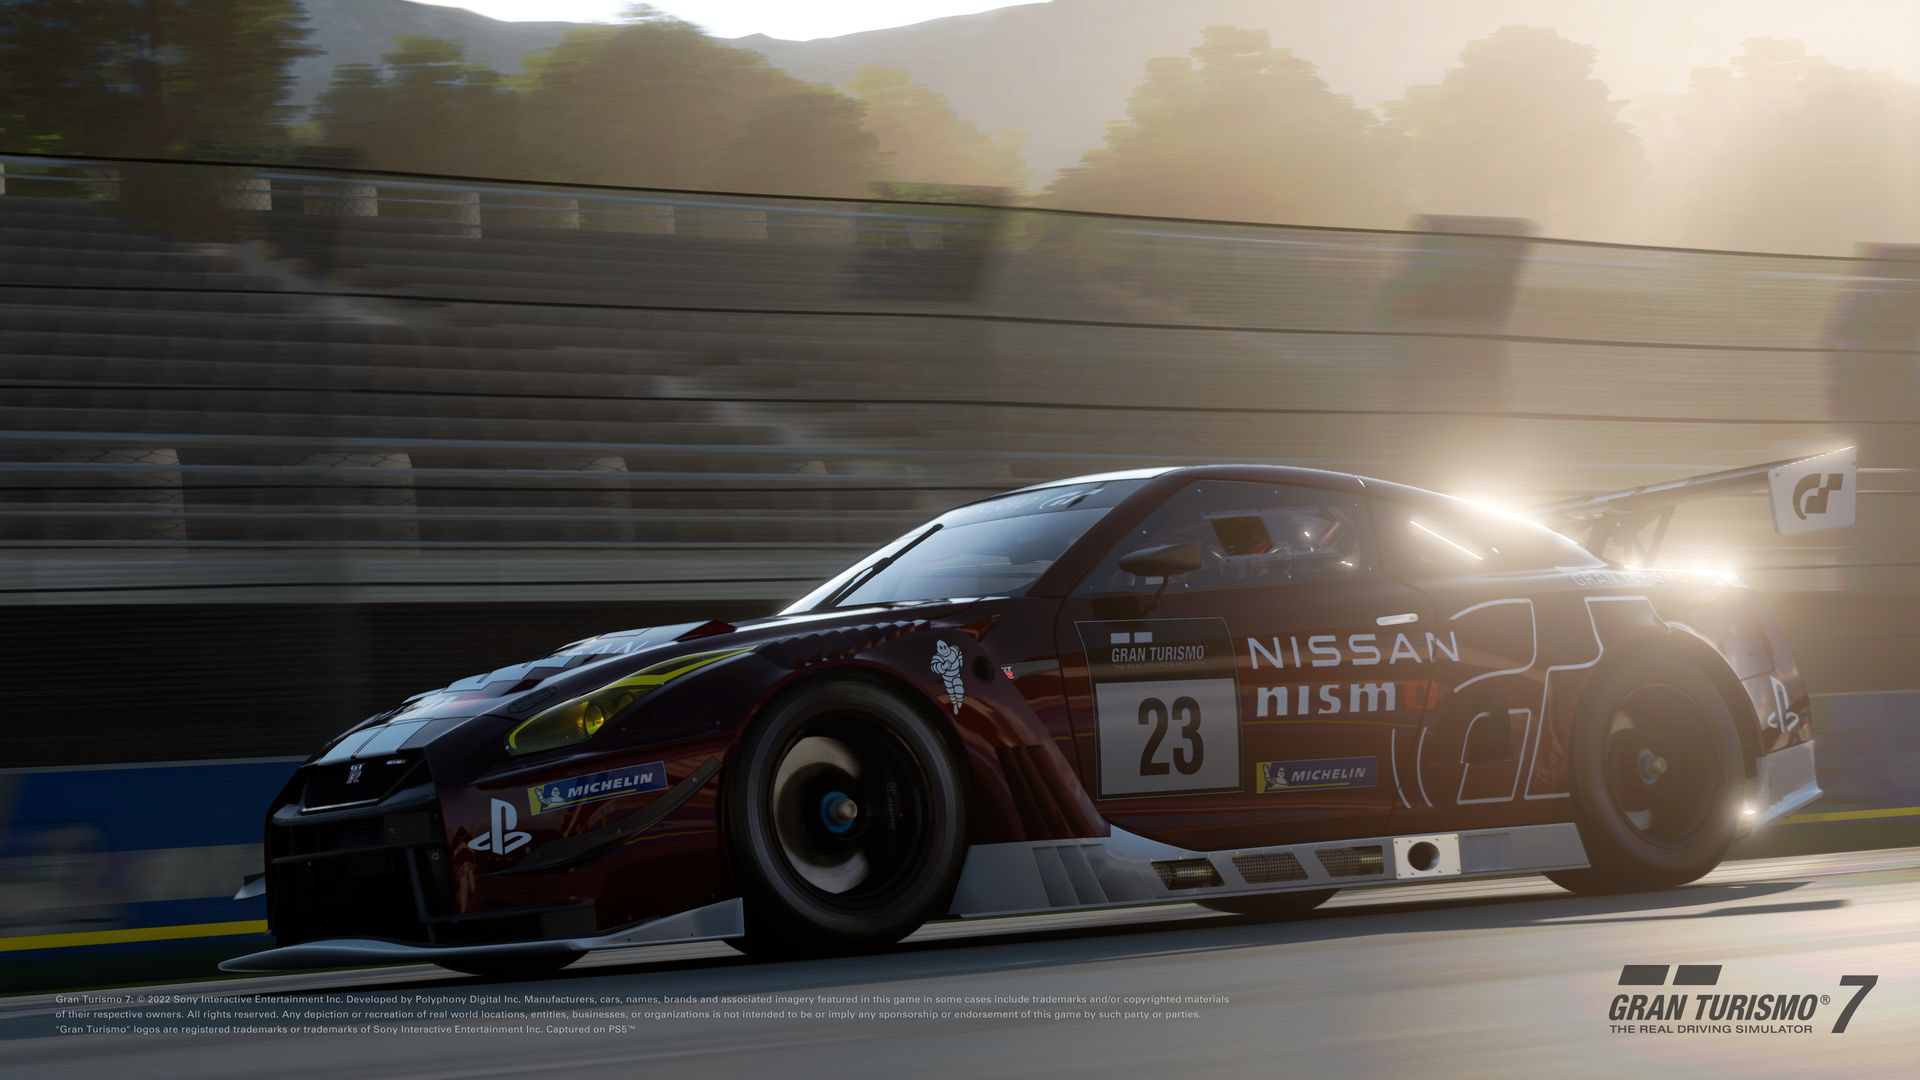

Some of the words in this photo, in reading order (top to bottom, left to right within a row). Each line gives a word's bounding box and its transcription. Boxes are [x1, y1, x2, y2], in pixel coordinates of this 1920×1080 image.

[1111, 647, 1146, 663] GRAN
[1149, 645, 1205, 662] TURISMO
[1247, 631, 1460, 670] NISSAN
[1256, 679, 1439, 718] nismo
[1137, 695, 1205, 777] 23
[567, 772, 654, 799] MICHELIN
[1291, 767, 1367, 782] MICHELIN
